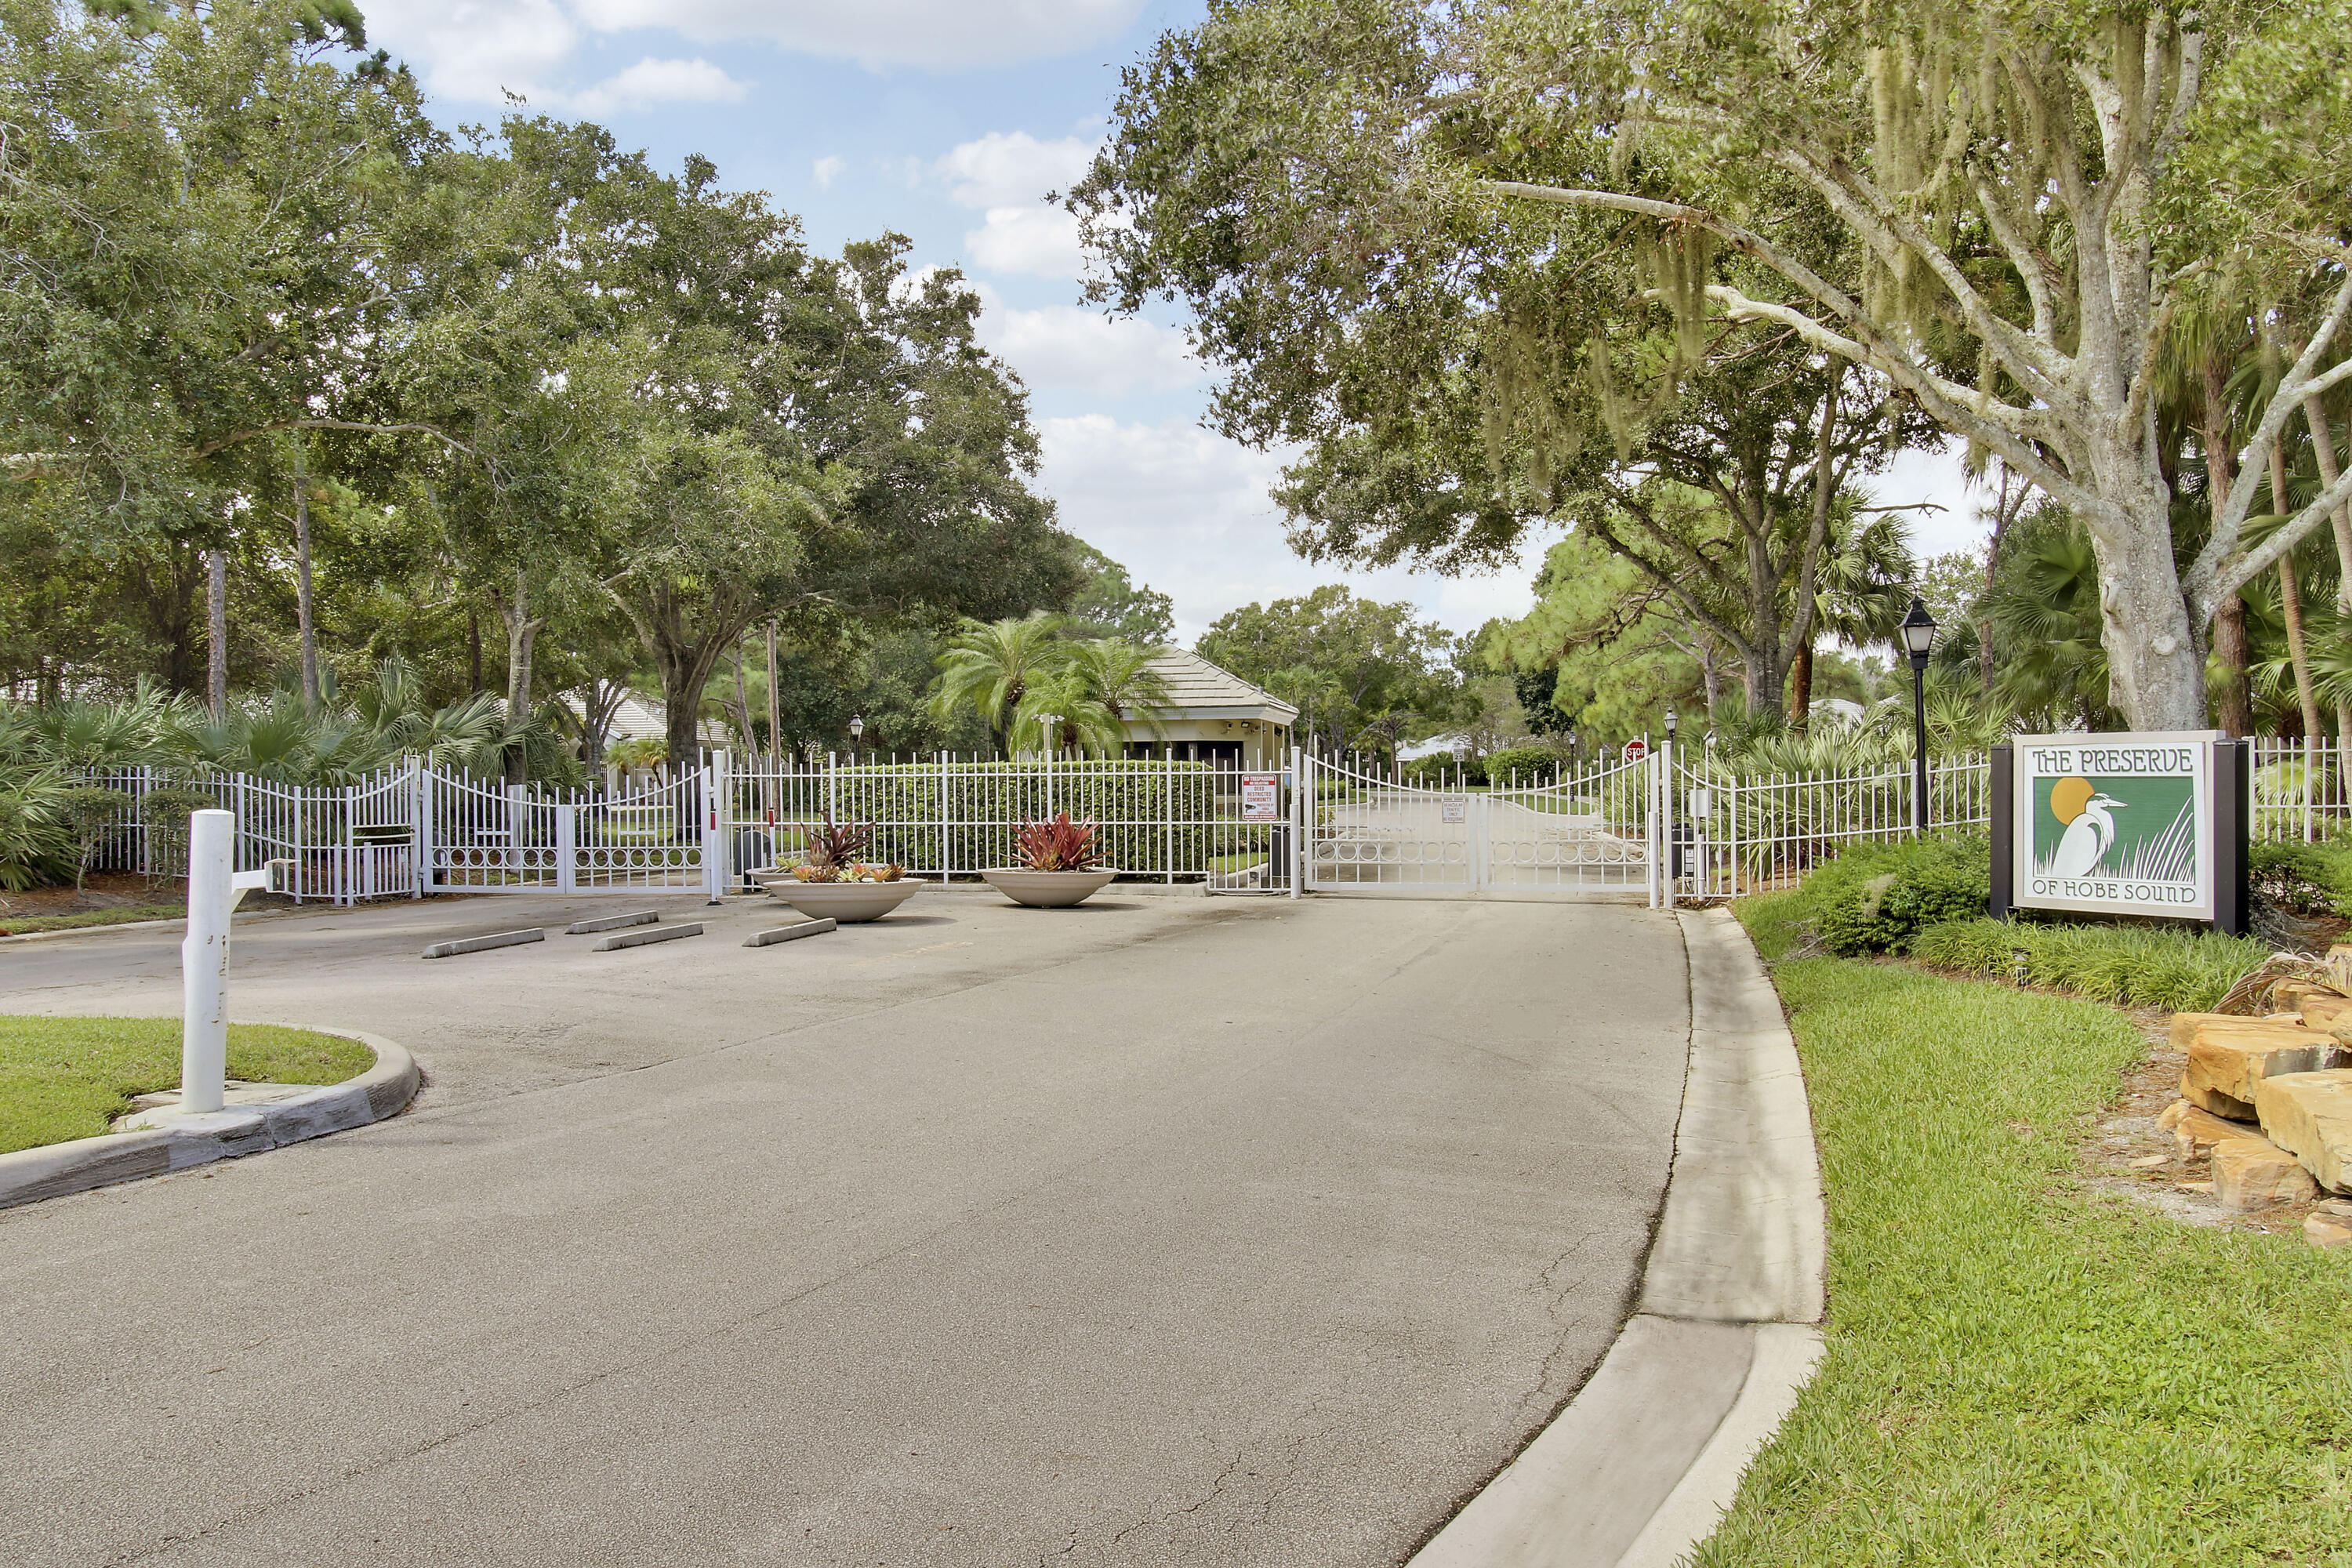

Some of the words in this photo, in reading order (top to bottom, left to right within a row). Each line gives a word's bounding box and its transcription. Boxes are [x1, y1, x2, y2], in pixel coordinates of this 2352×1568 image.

[1627, 747, 1645, 757] STOP
[2032, 749, 2072, 772] THE
[2078, 749, 2194, 772] PRESERVE
[2032, 879, 2058, 895] OF
[2063, 880, 2118, 898] HOBE
[2125, 884, 2196, 903] SOUND
